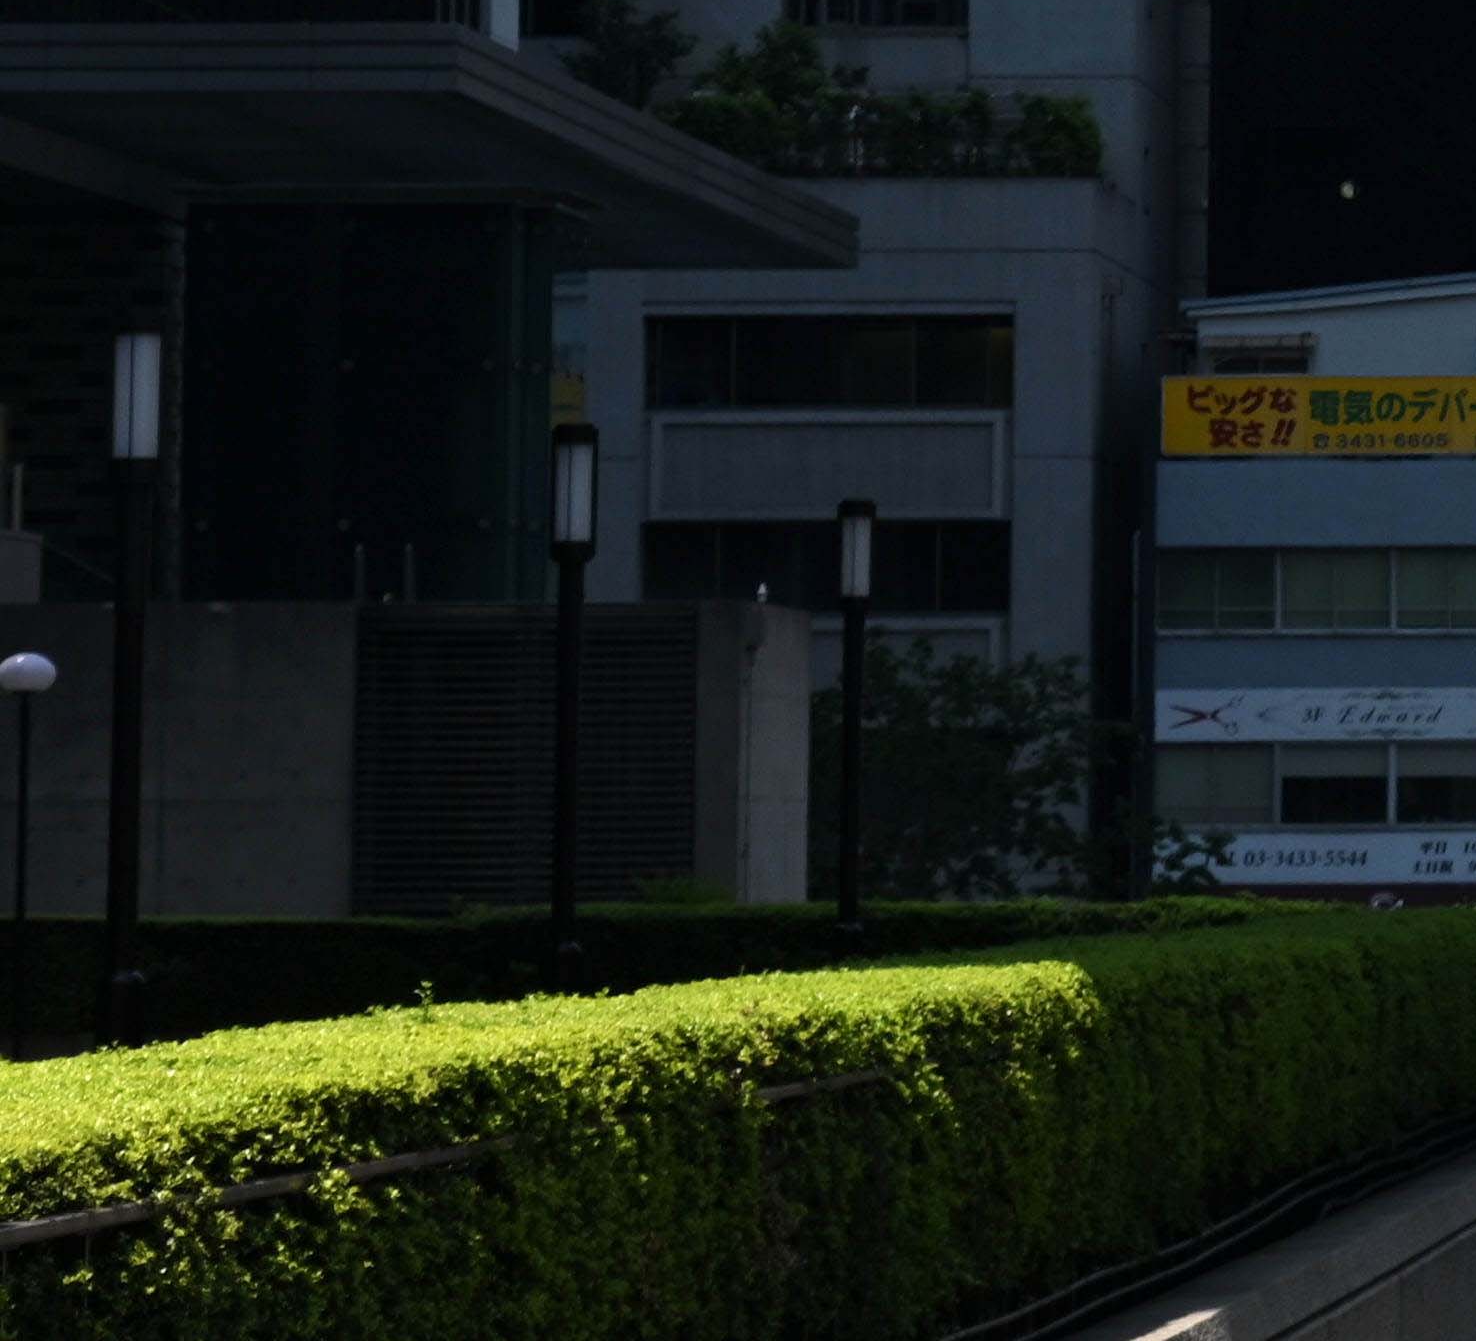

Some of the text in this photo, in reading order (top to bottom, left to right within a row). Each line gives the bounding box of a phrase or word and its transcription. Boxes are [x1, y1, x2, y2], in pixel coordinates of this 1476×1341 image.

[1188, 385, 1296, 415] ビッグな
[1209, 417, 1296, 448] 安さ!!
[1243, 848, 1369, 868] 03-3433-5544
